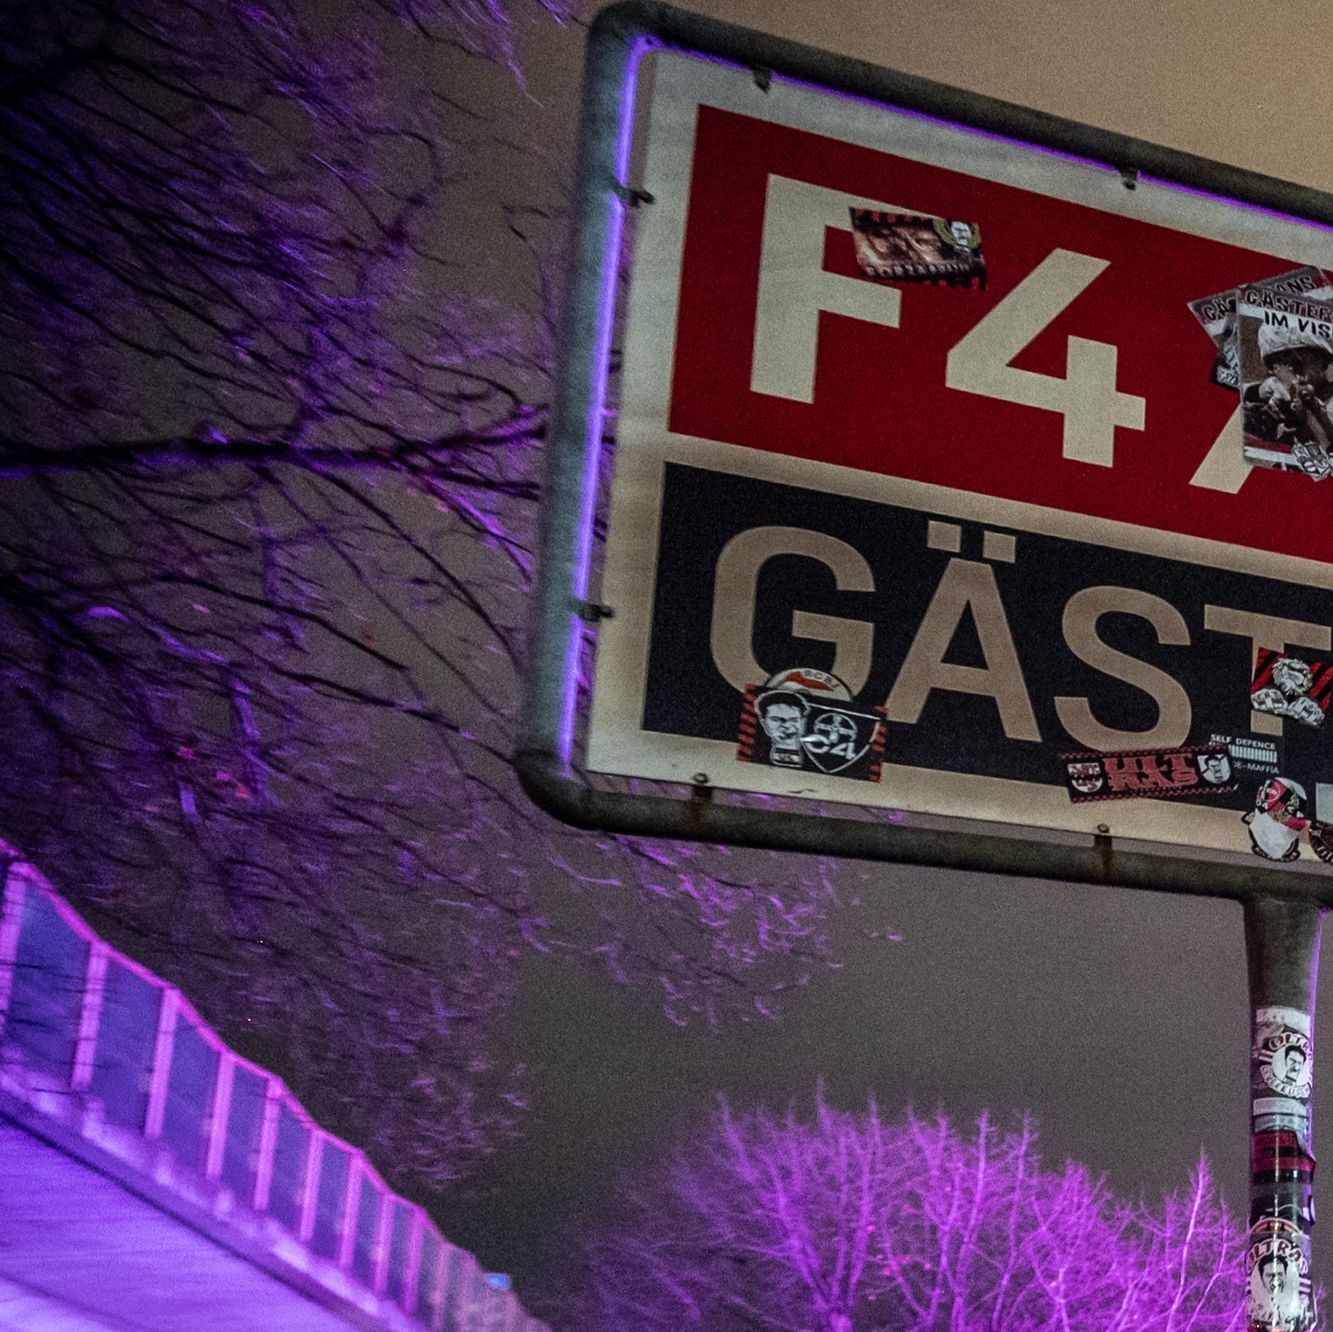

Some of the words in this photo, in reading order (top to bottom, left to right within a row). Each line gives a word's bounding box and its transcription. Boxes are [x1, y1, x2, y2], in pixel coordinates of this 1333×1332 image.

[750, 174, 1146, 468] F4
[1264, 310, 1288, 329] IM
[1210, 734, 1232, 744] SELF
[1236, 738, 1276, 750] DEFENCE
